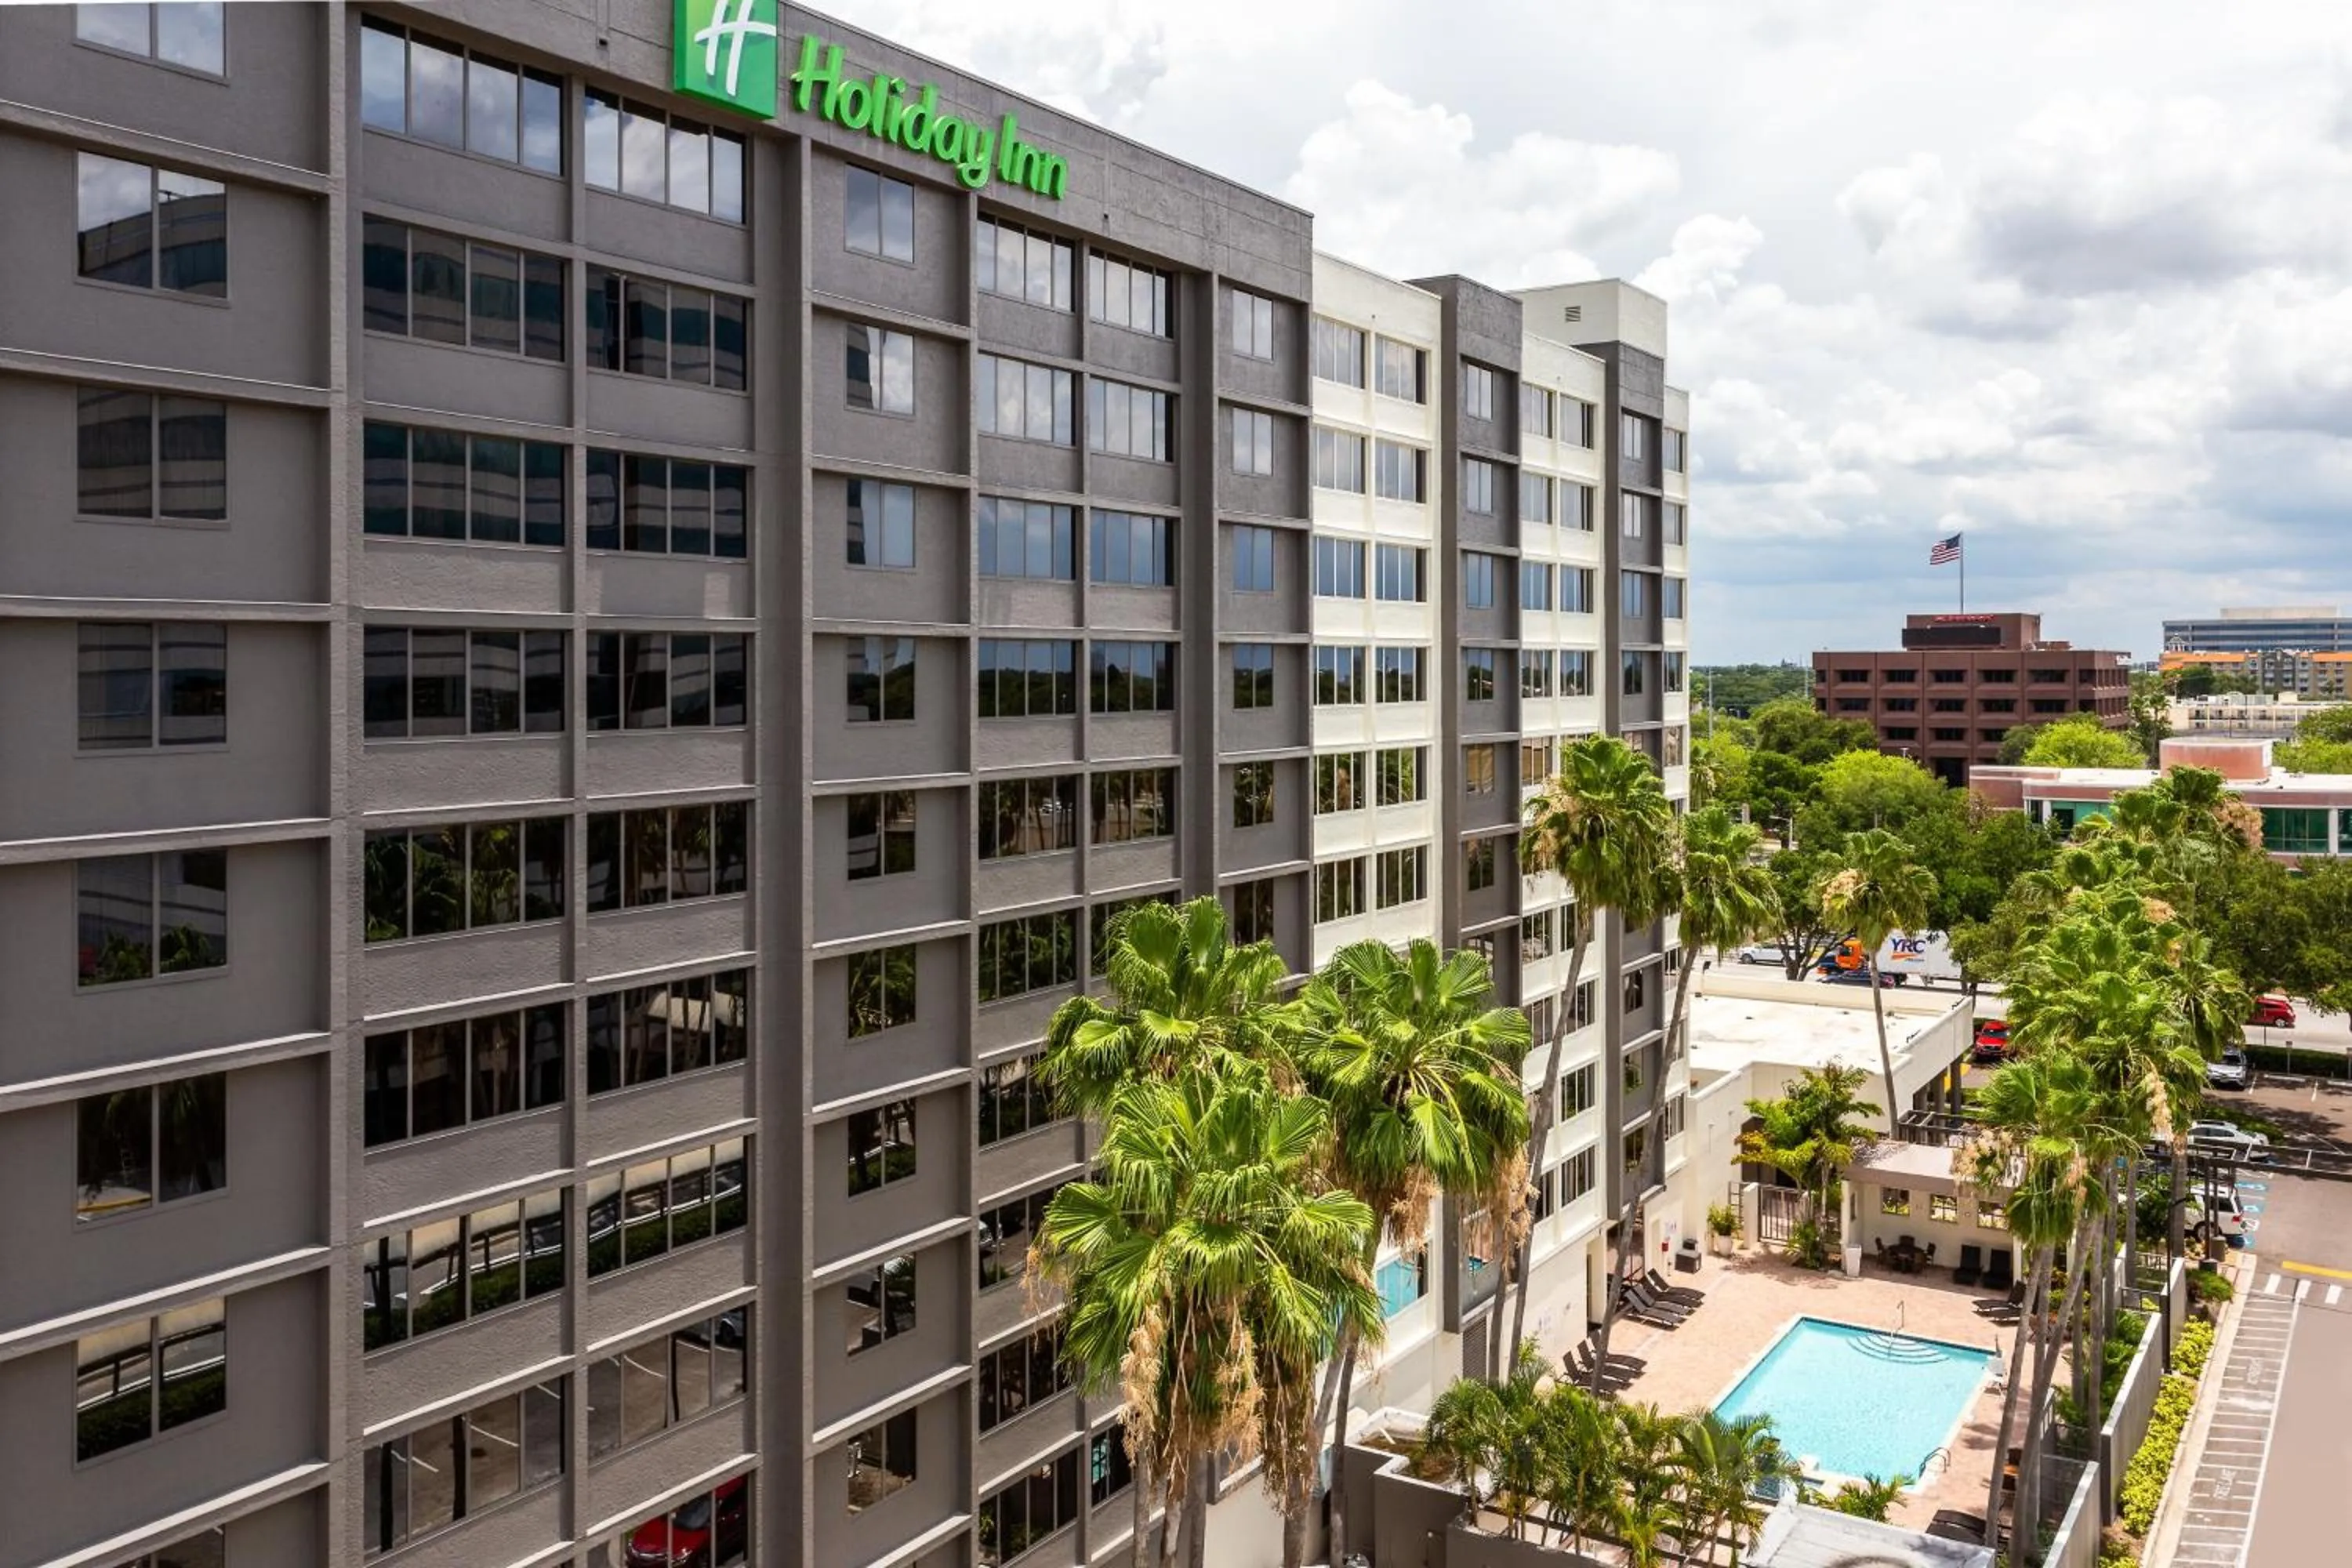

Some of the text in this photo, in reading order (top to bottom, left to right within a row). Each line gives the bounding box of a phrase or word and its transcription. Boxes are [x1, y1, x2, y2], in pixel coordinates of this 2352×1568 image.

[790, 34, 1069, 201] Holiday Inn
[1891, 938, 1926, 954] YRC
